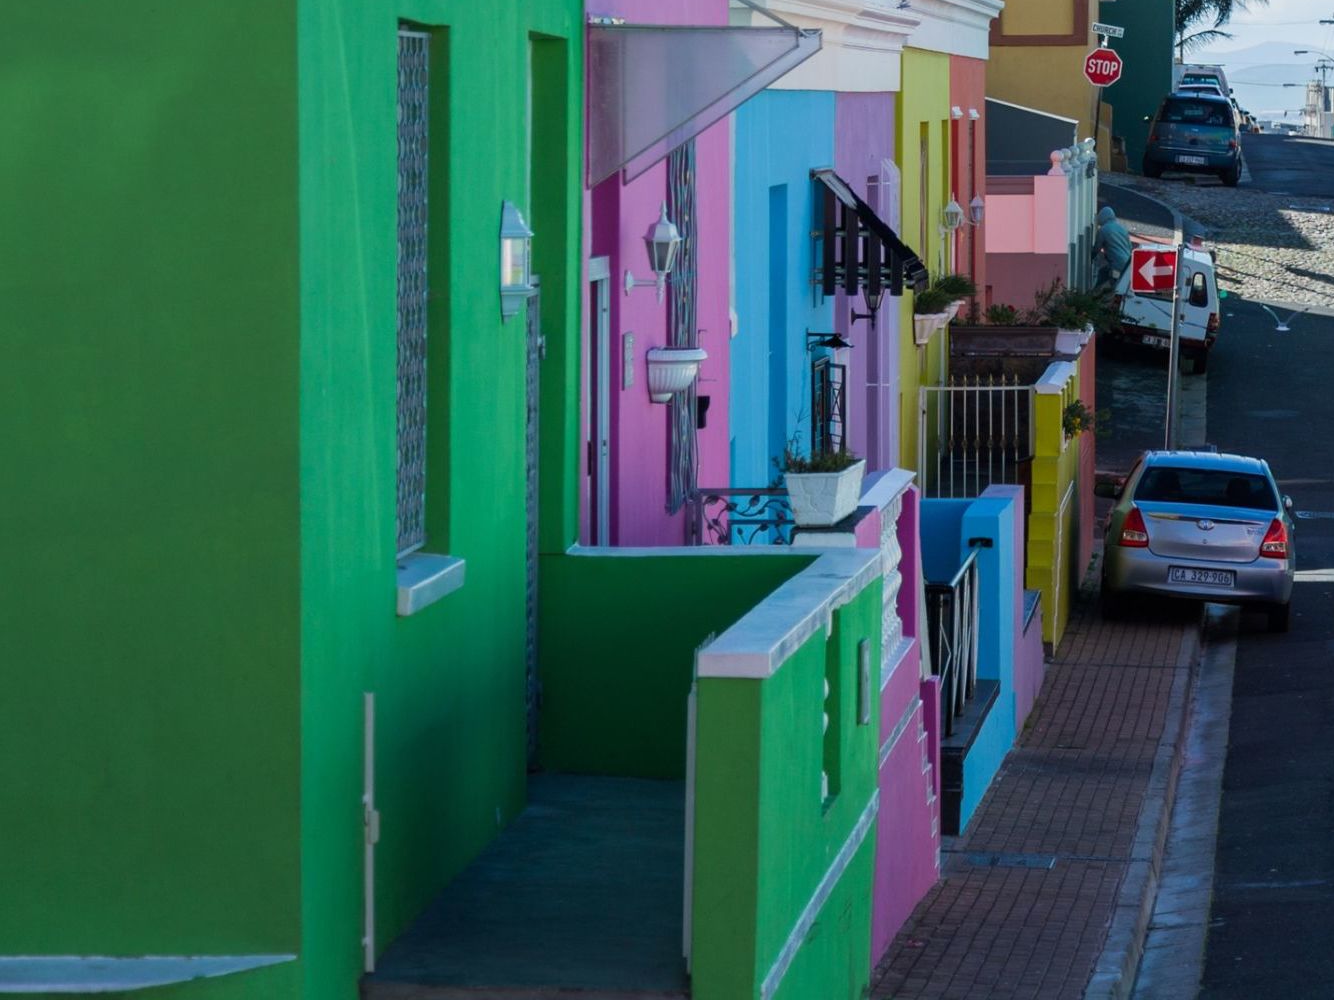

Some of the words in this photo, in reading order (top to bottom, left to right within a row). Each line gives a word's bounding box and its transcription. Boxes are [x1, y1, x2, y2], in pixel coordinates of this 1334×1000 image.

[1093, 24, 1117, 35] CHURCH
[1088, 59, 1118, 76] STOP
[1174, 568, 1186, 580] CA
